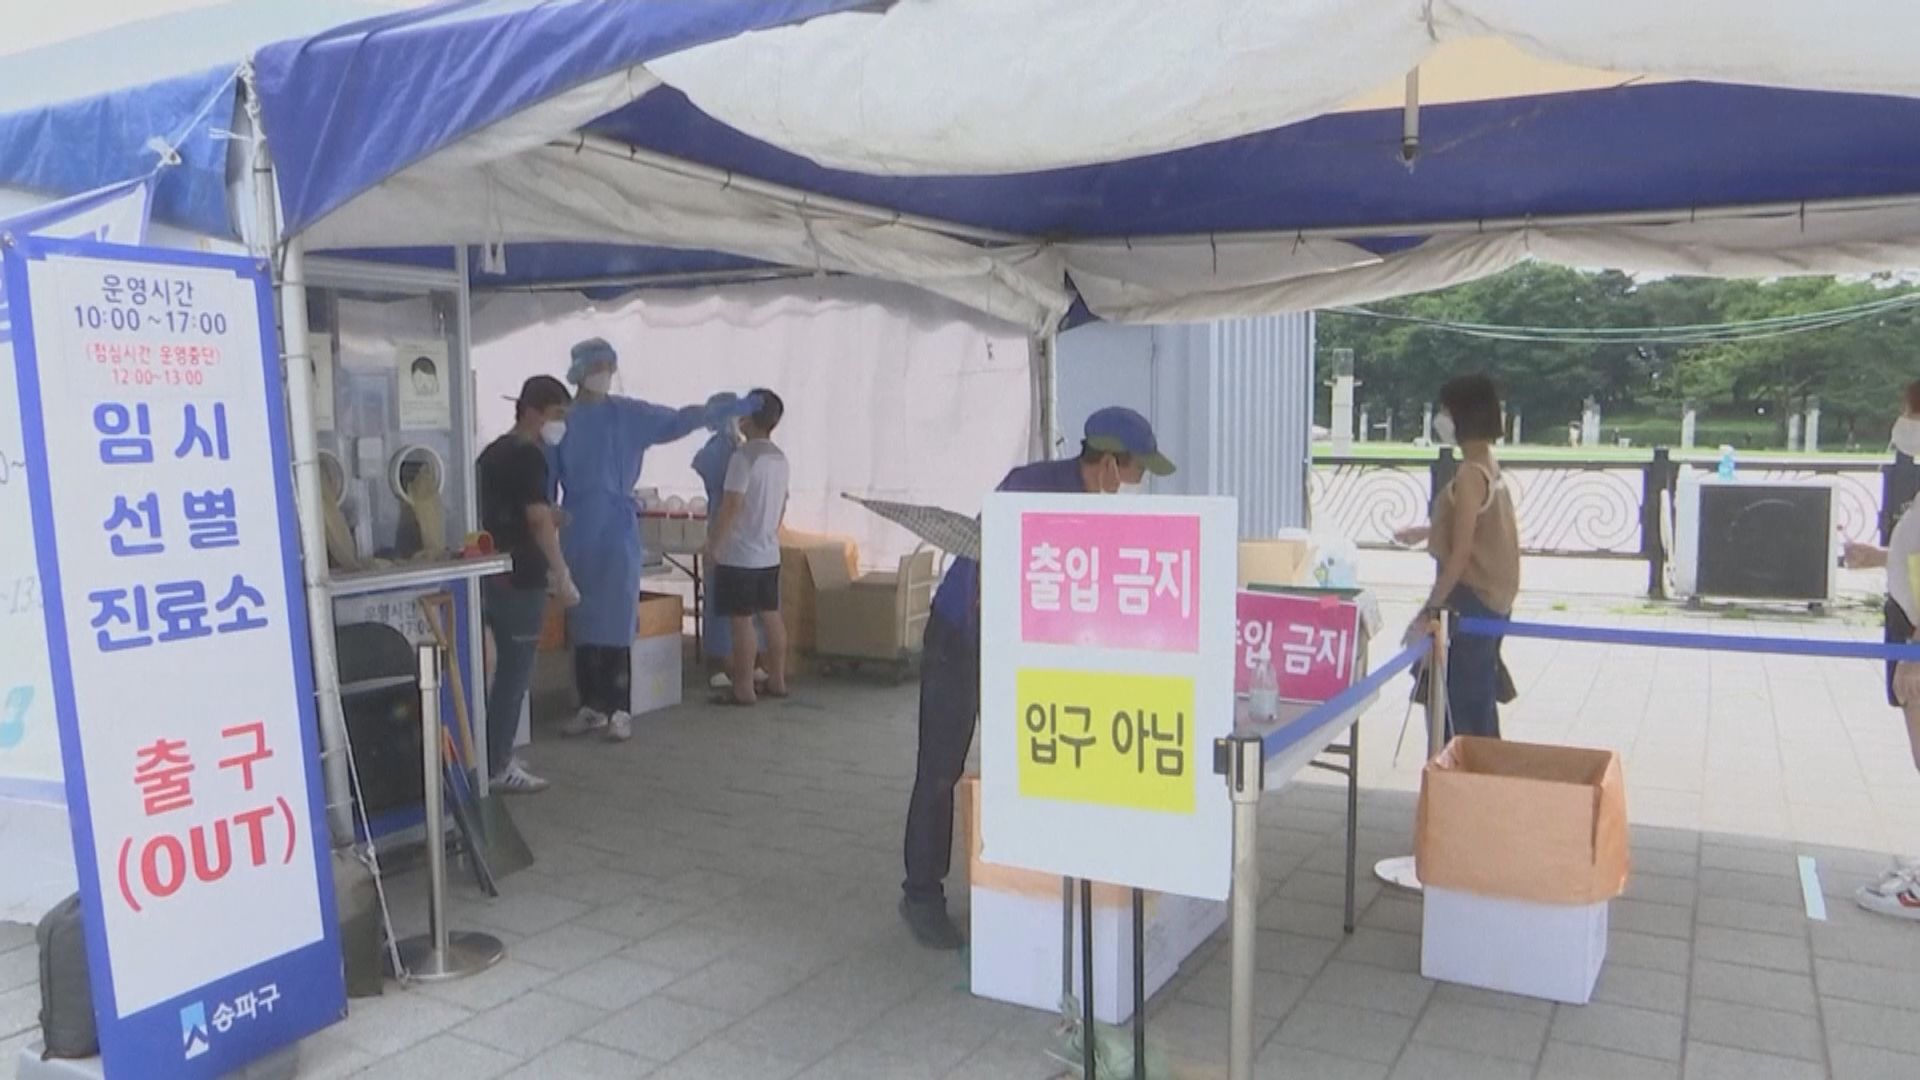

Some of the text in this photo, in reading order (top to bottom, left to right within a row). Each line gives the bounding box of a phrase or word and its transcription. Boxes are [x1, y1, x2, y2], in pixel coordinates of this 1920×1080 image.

[102, 274, 194, 307] 운영시간
[85, 343, 151, 365] (점심시간
[87, 574, 270, 653] 진료소
[1025, 542, 1192, 618] 출입 금지
[1236, 618, 1351, 680] 입 금지
[1025, 702, 1185, 777] 입구 아님
[118, 795, 297, 912] (OUT)
[210, 983, 282, 1033] 송파구
